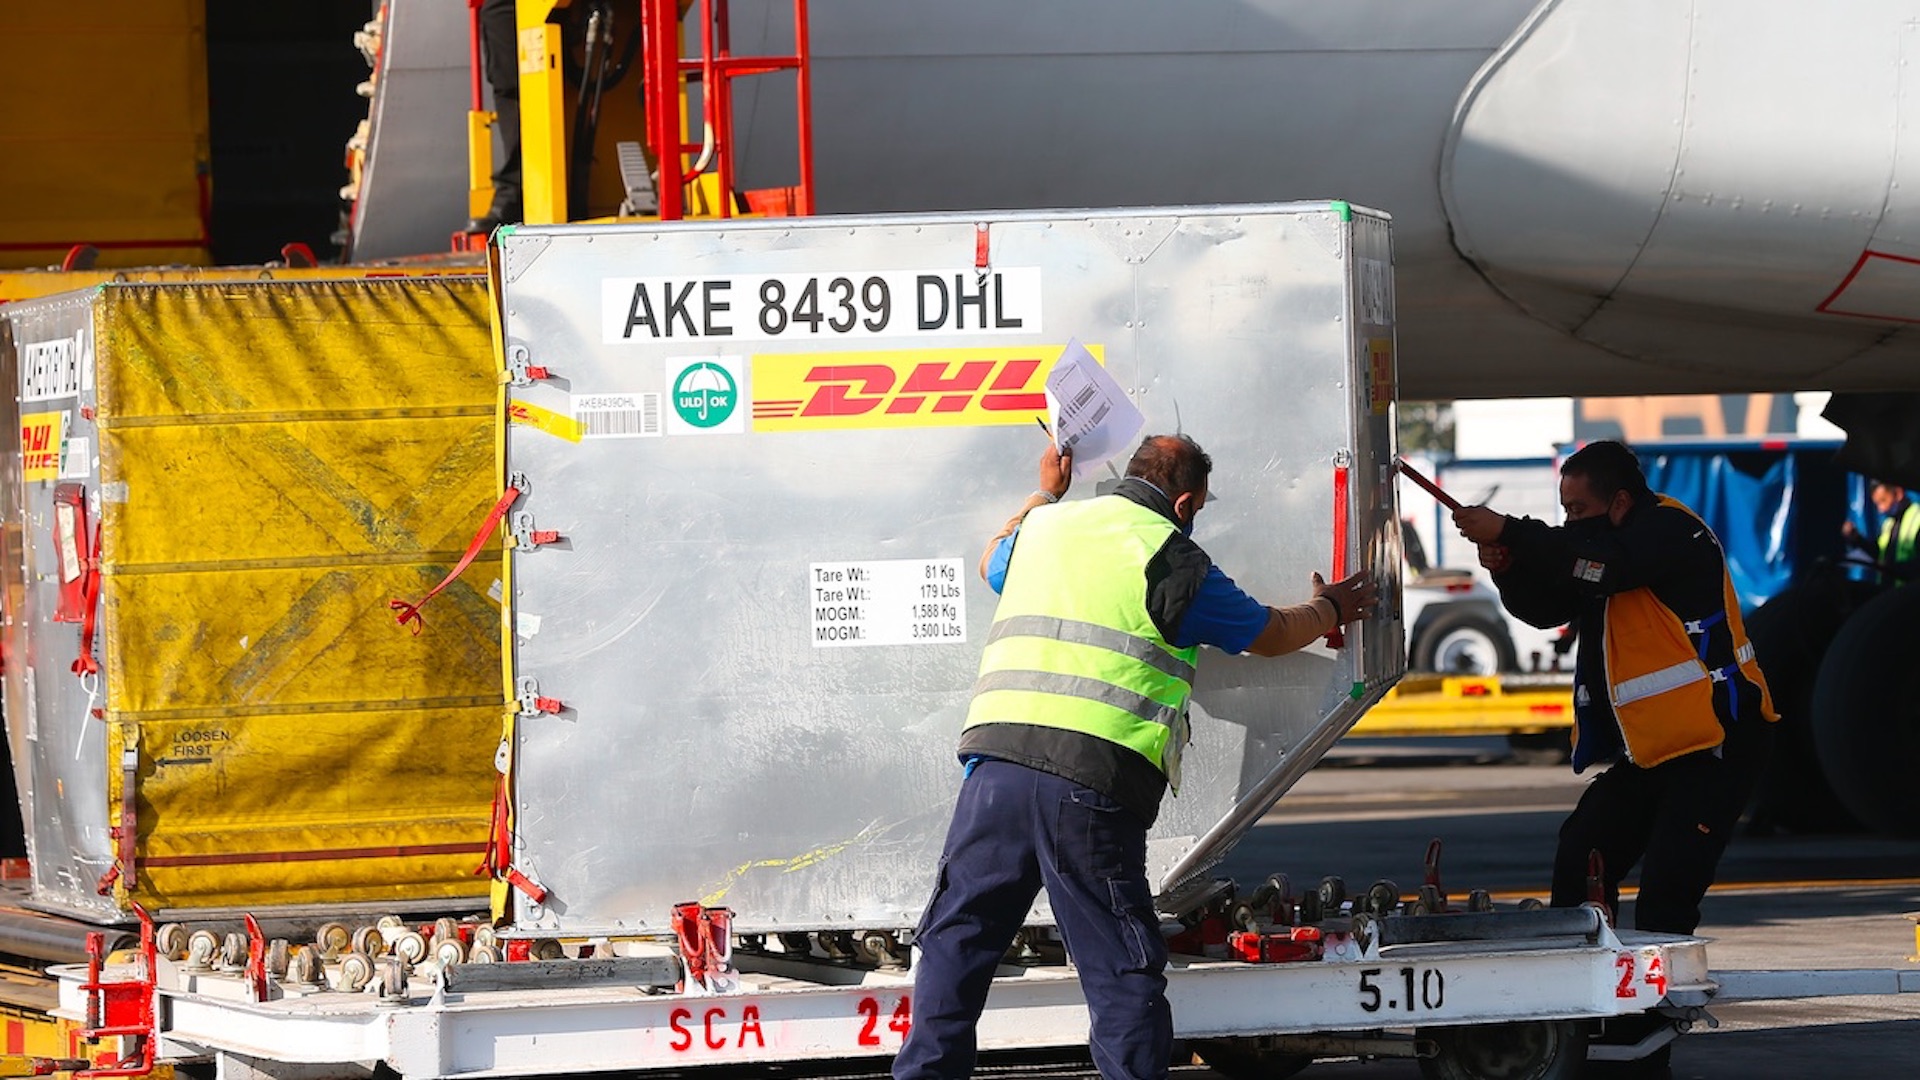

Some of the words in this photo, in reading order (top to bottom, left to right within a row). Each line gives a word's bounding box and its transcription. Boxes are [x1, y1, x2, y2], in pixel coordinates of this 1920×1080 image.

[623, 280, 734, 339] AKE
[758, 276, 891, 336] 8439
[917, 272, 1024, 331] DHL
[800, 359, 1049, 417] DHL
[578, 397, 636, 409] AKE8439DHL
[679, 396, 703, 408] ULD
[710, 396, 728, 408] OK
[815, 568, 843, 582] Tare
[847, 567, 870, 582] Wt.:
[925, 565, 937, 579] 81
[940, 564, 955, 581] Kg
[816, 588, 843, 602] Tare
[847, 587, 871, 601] Wt.:
[921, 584, 938, 598] 179
[941, 584, 961, 598] Lbs
[815, 606, 866, 621] MOGM.:
[912, 604, 939, 619] 1,588
[942, 603, 956, 620] Kg
[816, 626, 866, 641] MOGM.:
[912, 623, 940, 639] 3,500
[942, 623, 962, 636] Lbs
[173, 730, 230, 743] LOOSEN
[173, 745, 212, 757] FIRST
[1614, 955, 1668, 998] 24
[1360, 968, 1444, 1012] 5.10
[669, 1005, 765, 1051] SCA
[857, 995, 912, 1047] 24
